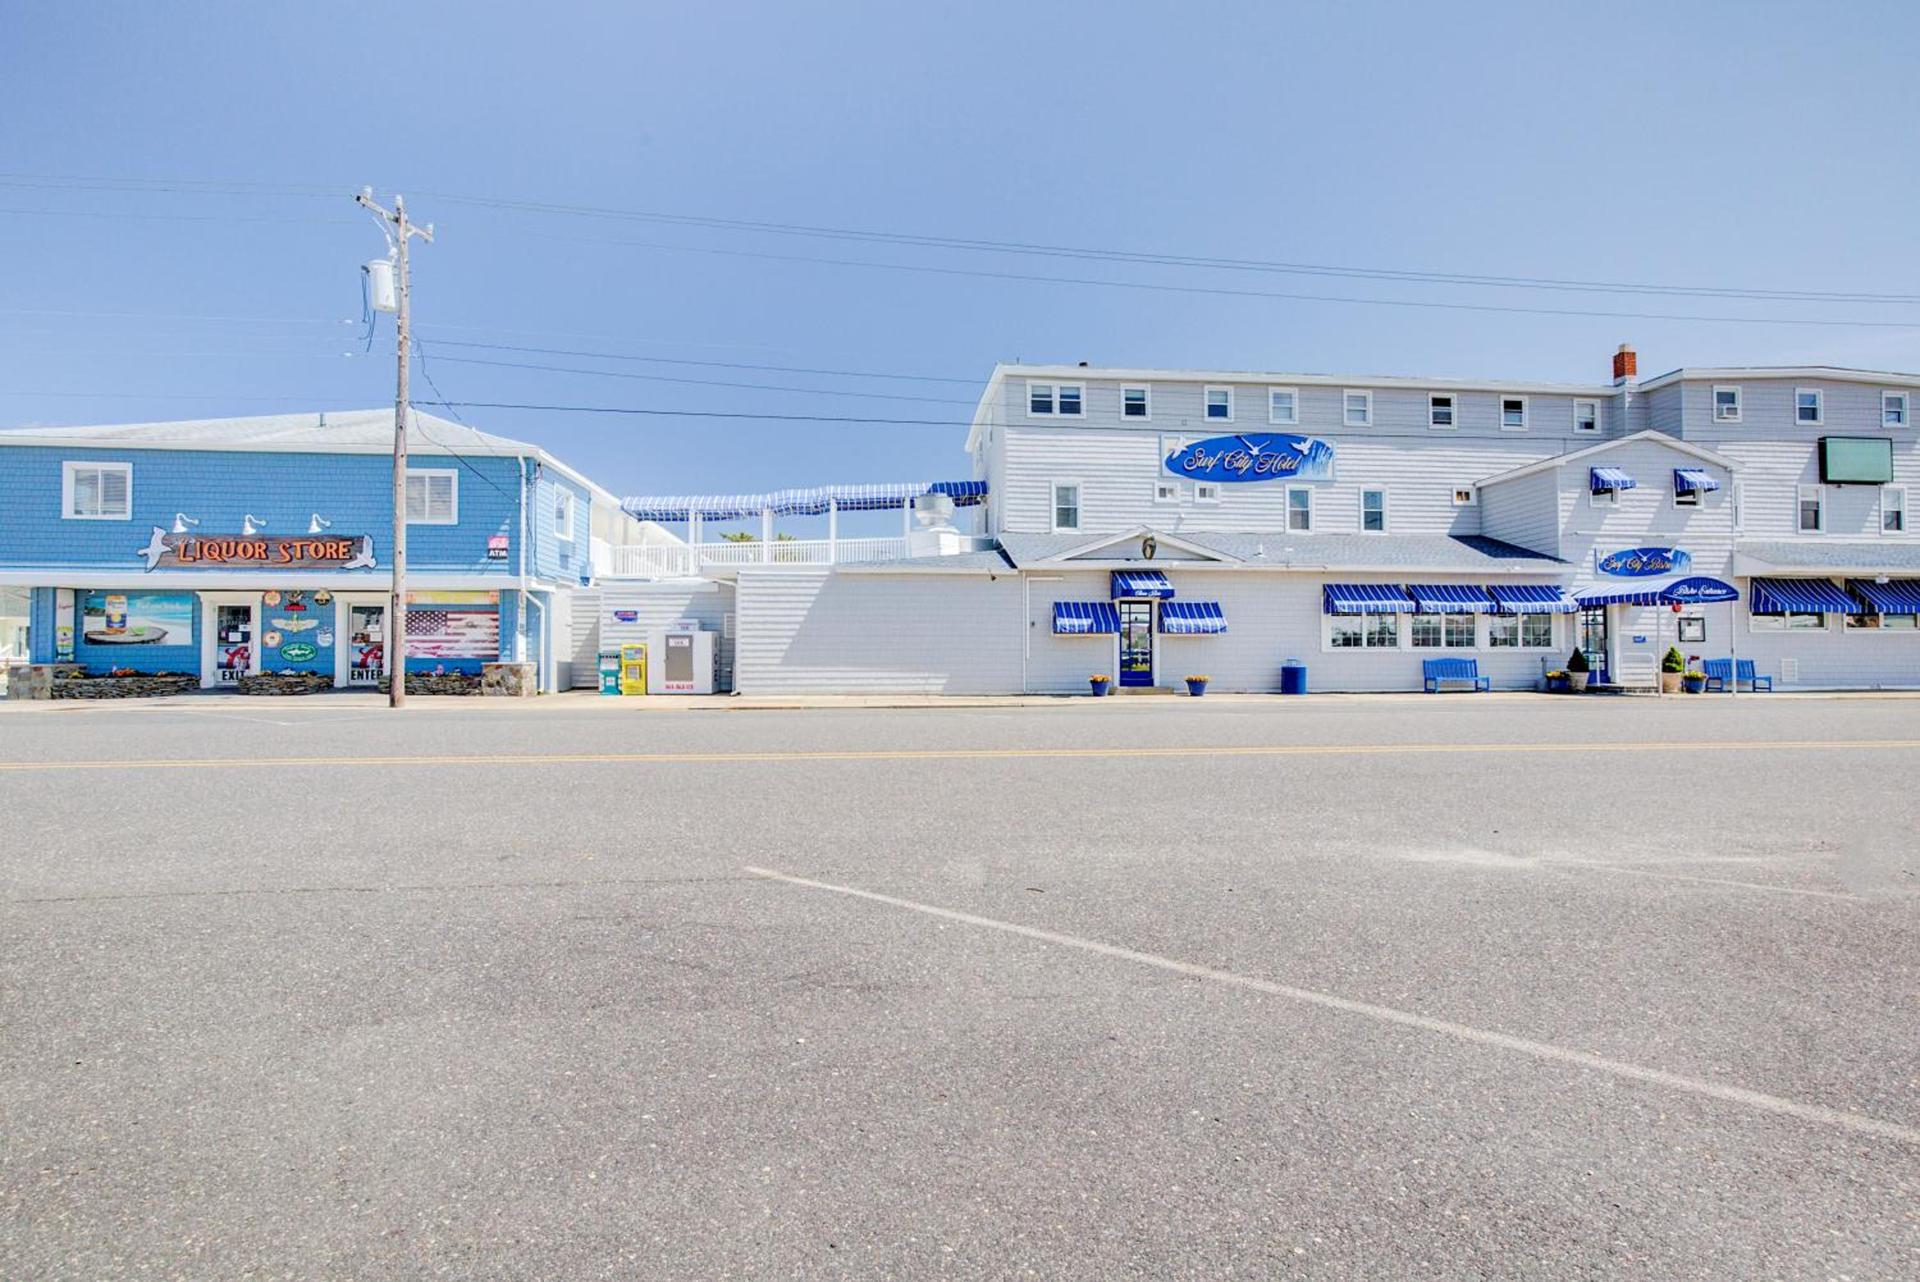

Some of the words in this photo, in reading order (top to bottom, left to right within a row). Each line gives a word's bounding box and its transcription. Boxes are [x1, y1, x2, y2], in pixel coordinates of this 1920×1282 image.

[1183, 448, 1224, 473] Surf
[1224, 450, 1253, 475] City
[1255, 451, 1300, 473] Hotel
[178, 541, 269, 562] LIQUOR
[273, 541, 353, 563] STORE
[222, 670, 246, 681] EXIT
